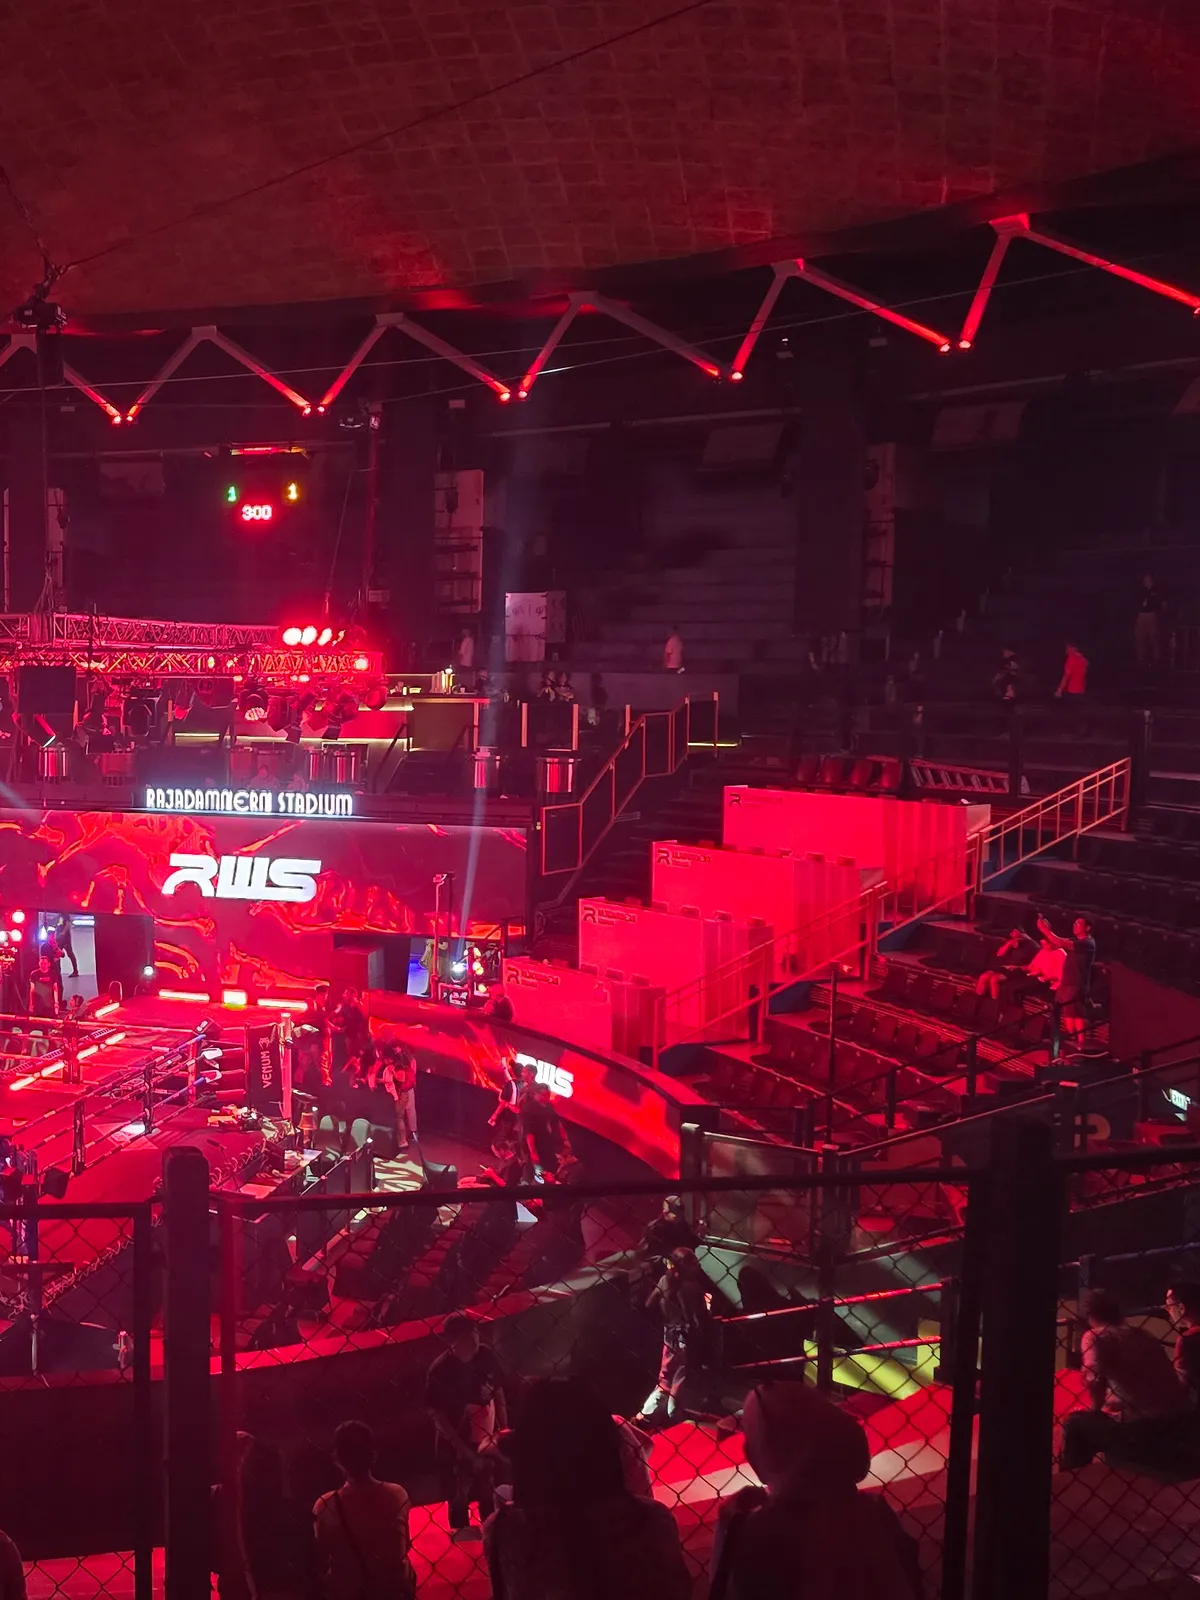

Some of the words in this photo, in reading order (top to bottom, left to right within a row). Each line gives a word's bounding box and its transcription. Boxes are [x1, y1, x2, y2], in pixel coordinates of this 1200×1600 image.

[287, 482, 298, 500] 1
[146, 788, 273, 813] RAJADAMNERN
[277, 792, 353, 816] STADIUM
[161, 852, 322, 903] RWS
[261, 1050, 273, 1089] VENUM
